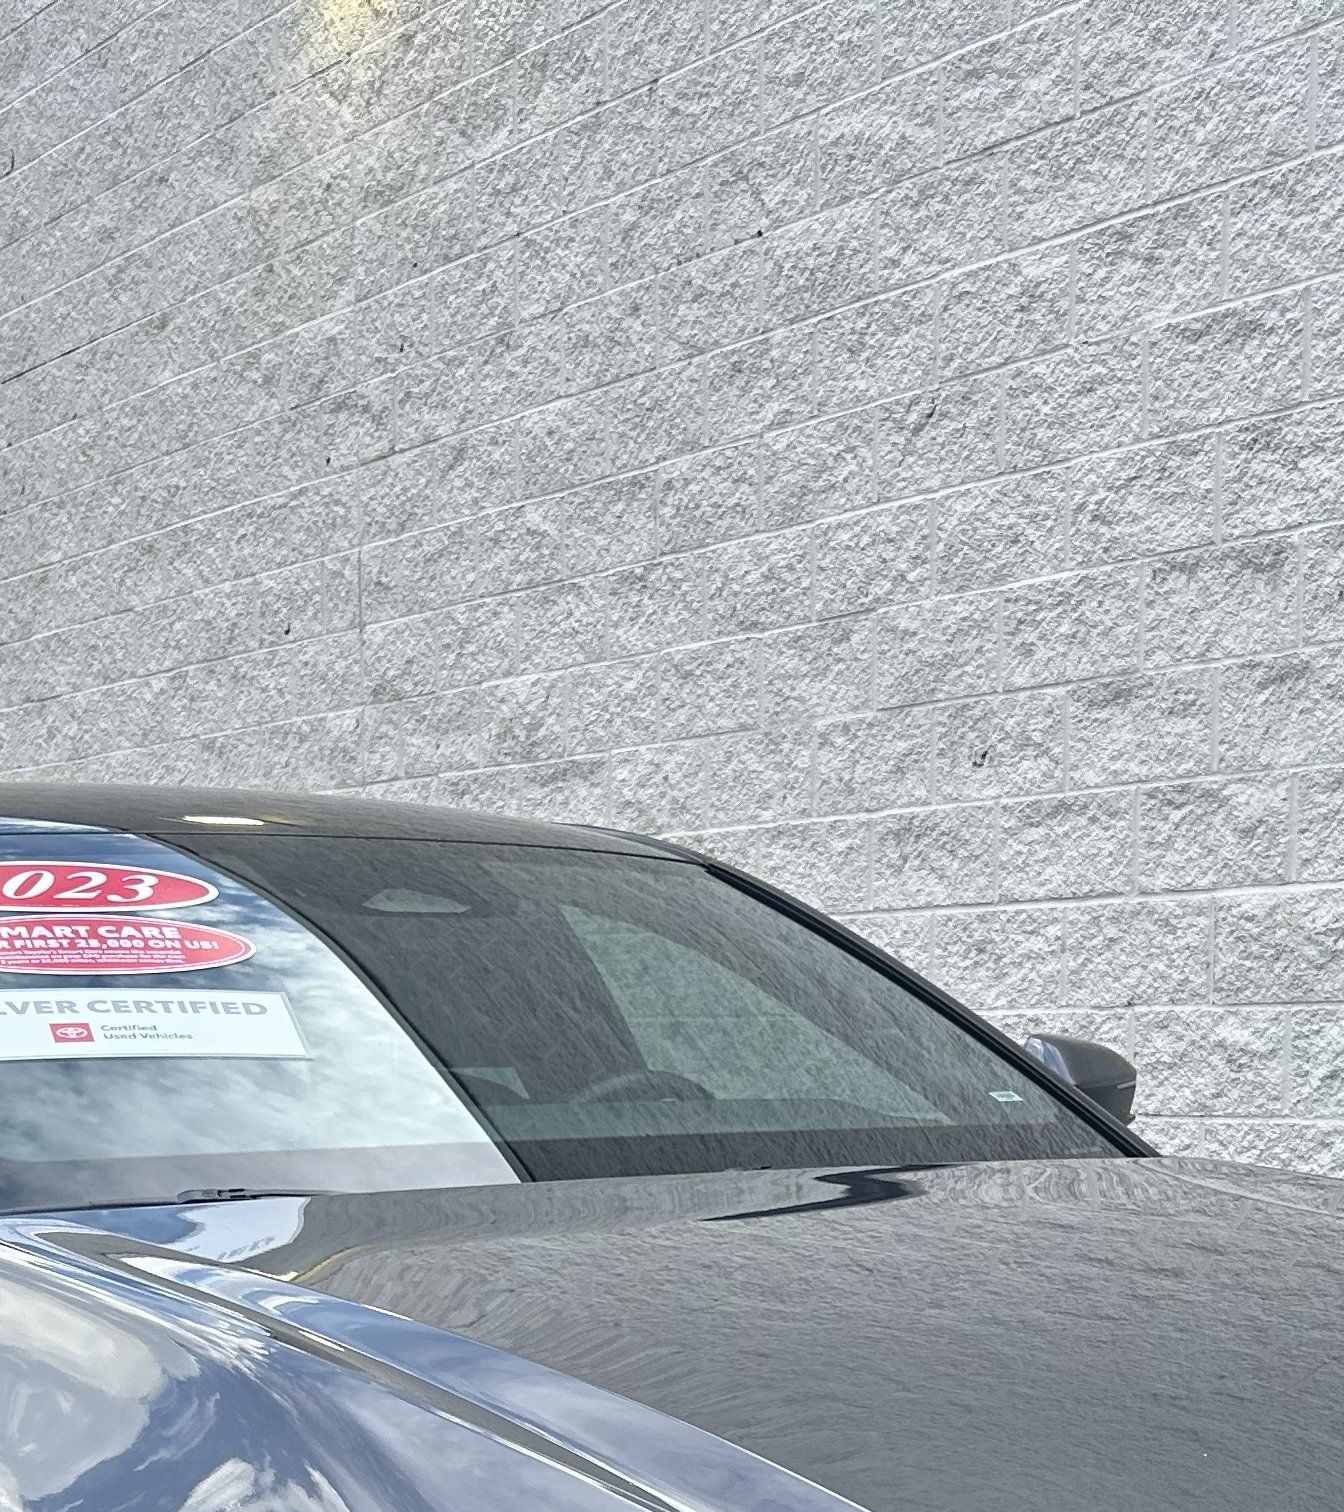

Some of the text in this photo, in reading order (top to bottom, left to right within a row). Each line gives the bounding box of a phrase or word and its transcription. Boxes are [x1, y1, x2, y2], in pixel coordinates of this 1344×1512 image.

[97, 925, 181, 939] CARE
[13, 938, 71, 949] FIRST
[147, 939, 182, 949] ON
[183, 939, 221, 950] US!
[86, 999, 268, 1016] CERTIFIED
[103, 1032, 194, 1040] Used Vehicles
